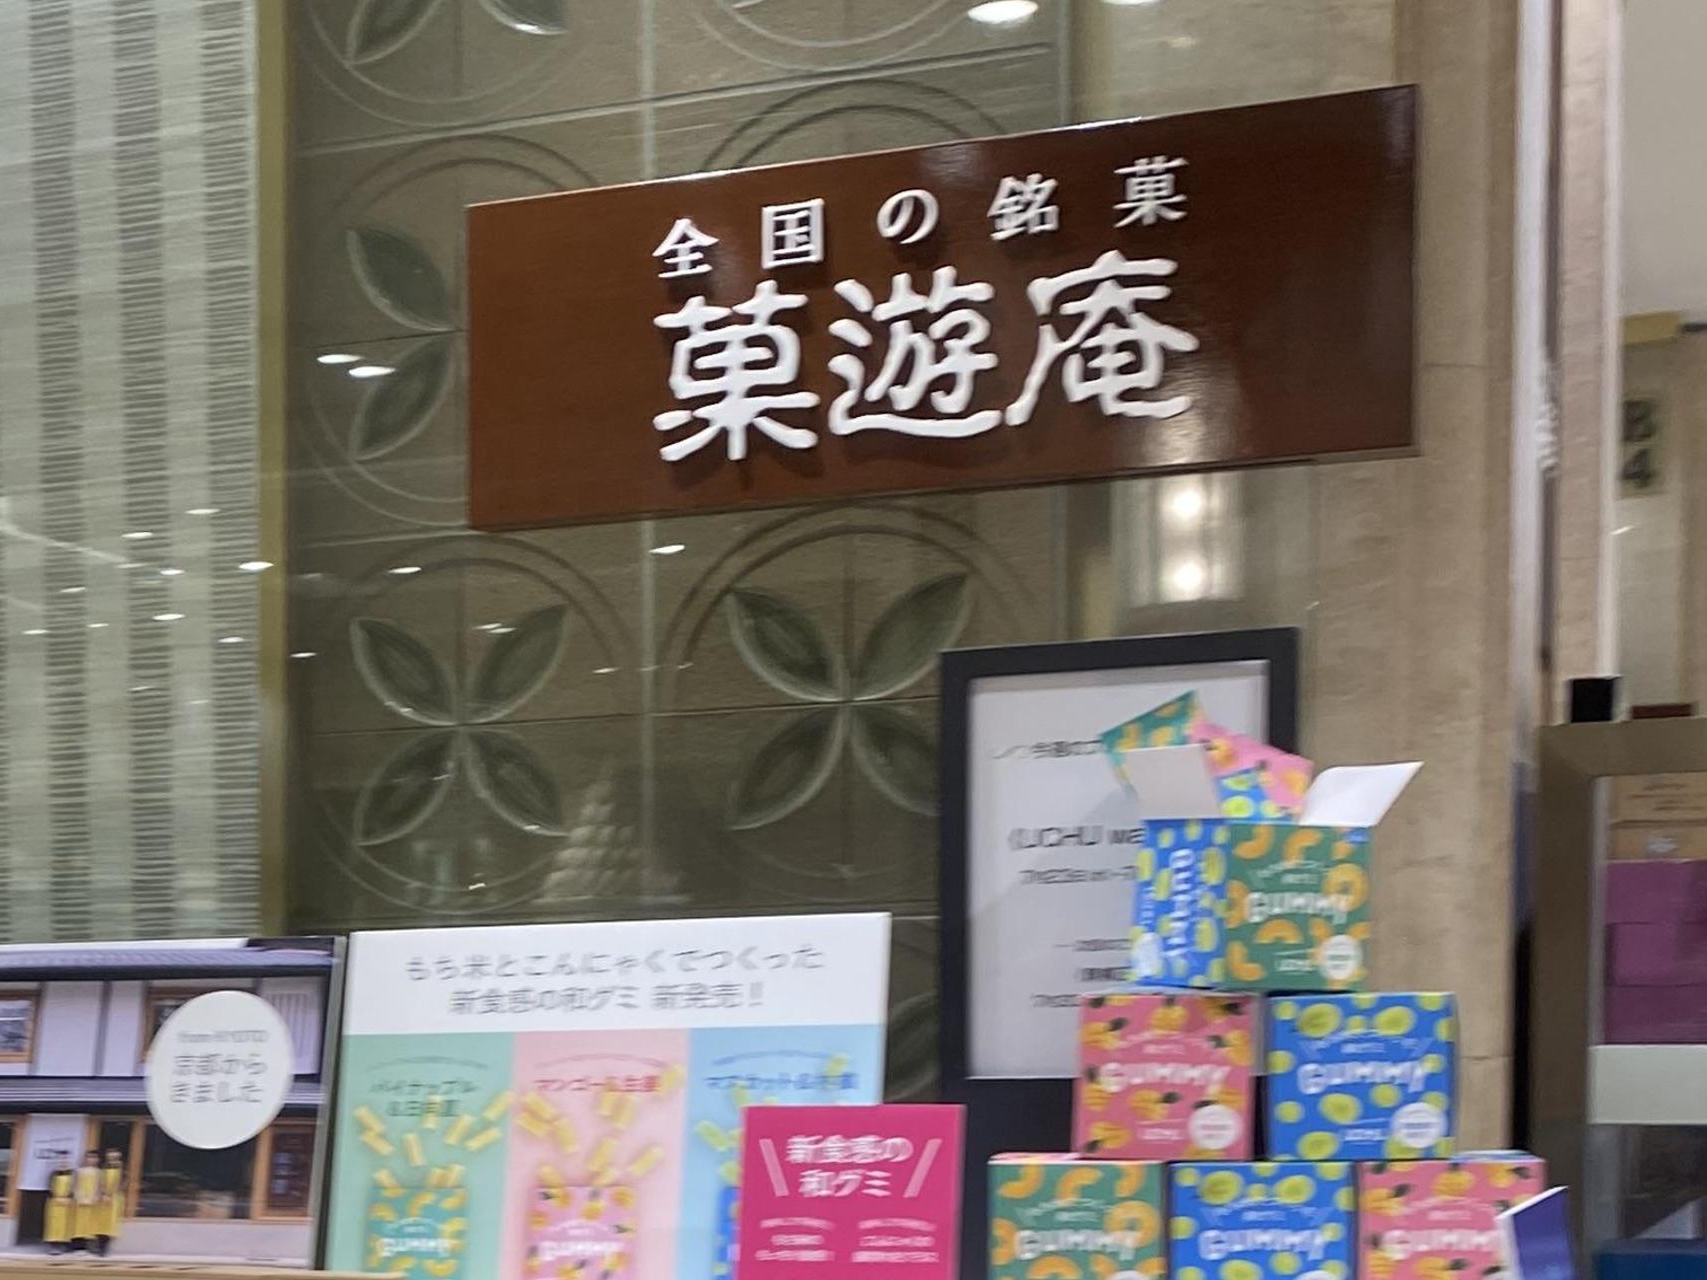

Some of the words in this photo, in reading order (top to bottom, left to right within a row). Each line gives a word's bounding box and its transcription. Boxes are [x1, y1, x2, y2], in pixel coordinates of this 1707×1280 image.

[653, 156, 1191, 279] 全国の銘菓
[652, 248, 1201, 463] 菓遊庵
